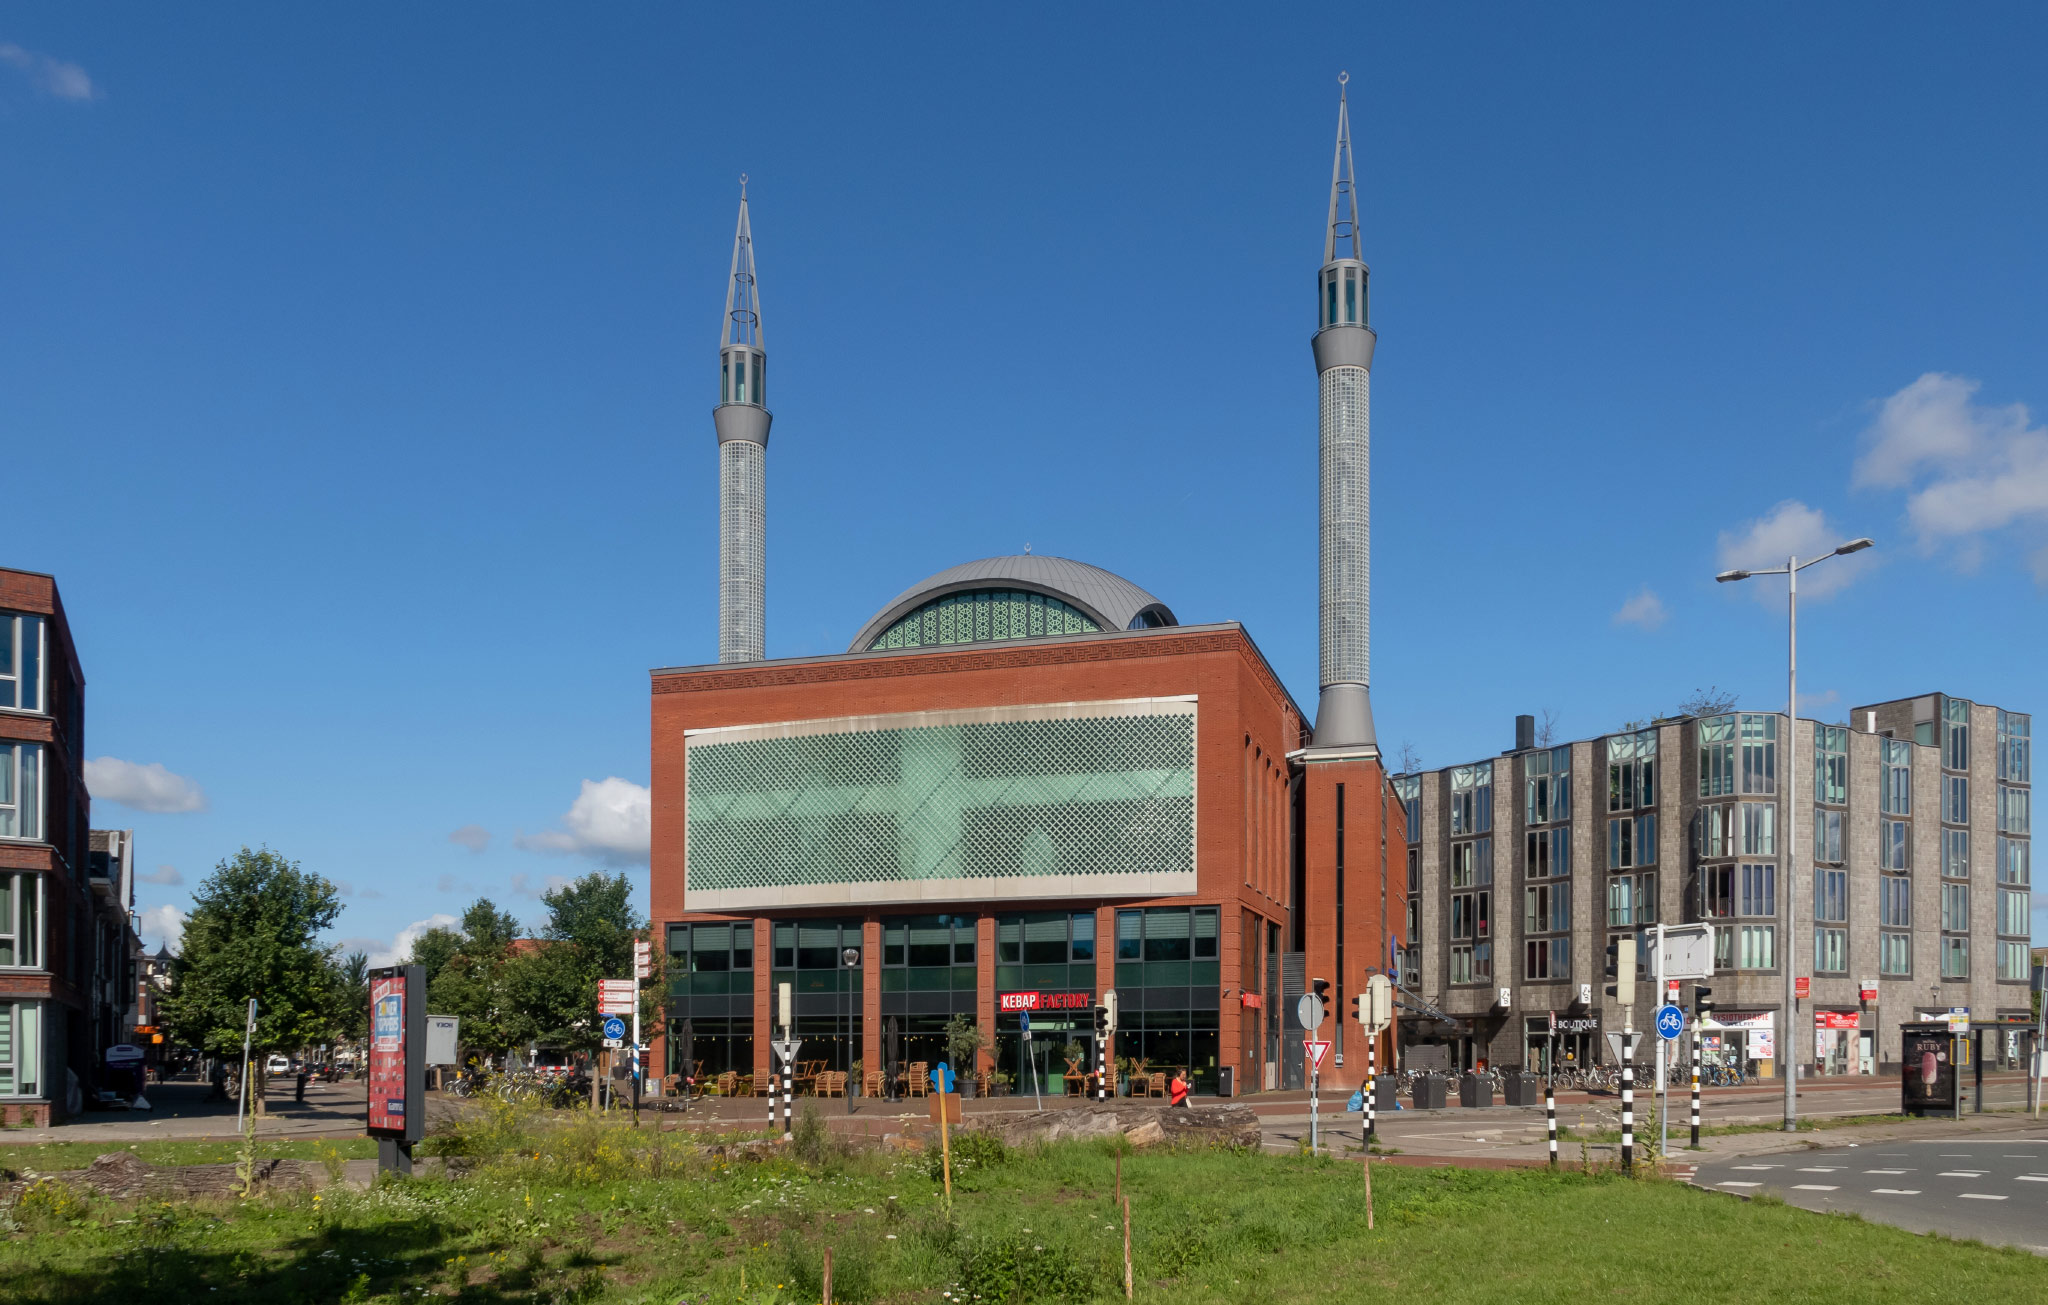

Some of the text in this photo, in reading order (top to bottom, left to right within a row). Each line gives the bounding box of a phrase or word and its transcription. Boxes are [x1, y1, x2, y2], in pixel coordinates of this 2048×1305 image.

[1002, 993, 1089, 1009] KEBAP FACTORY
[1712, 1013, 1769, 1021] FYSIOTHERAPIE
[1558, 1019, 1598, 1030] BOUTIQUE
[1917, 1043, 1941, 1051] RUBY
